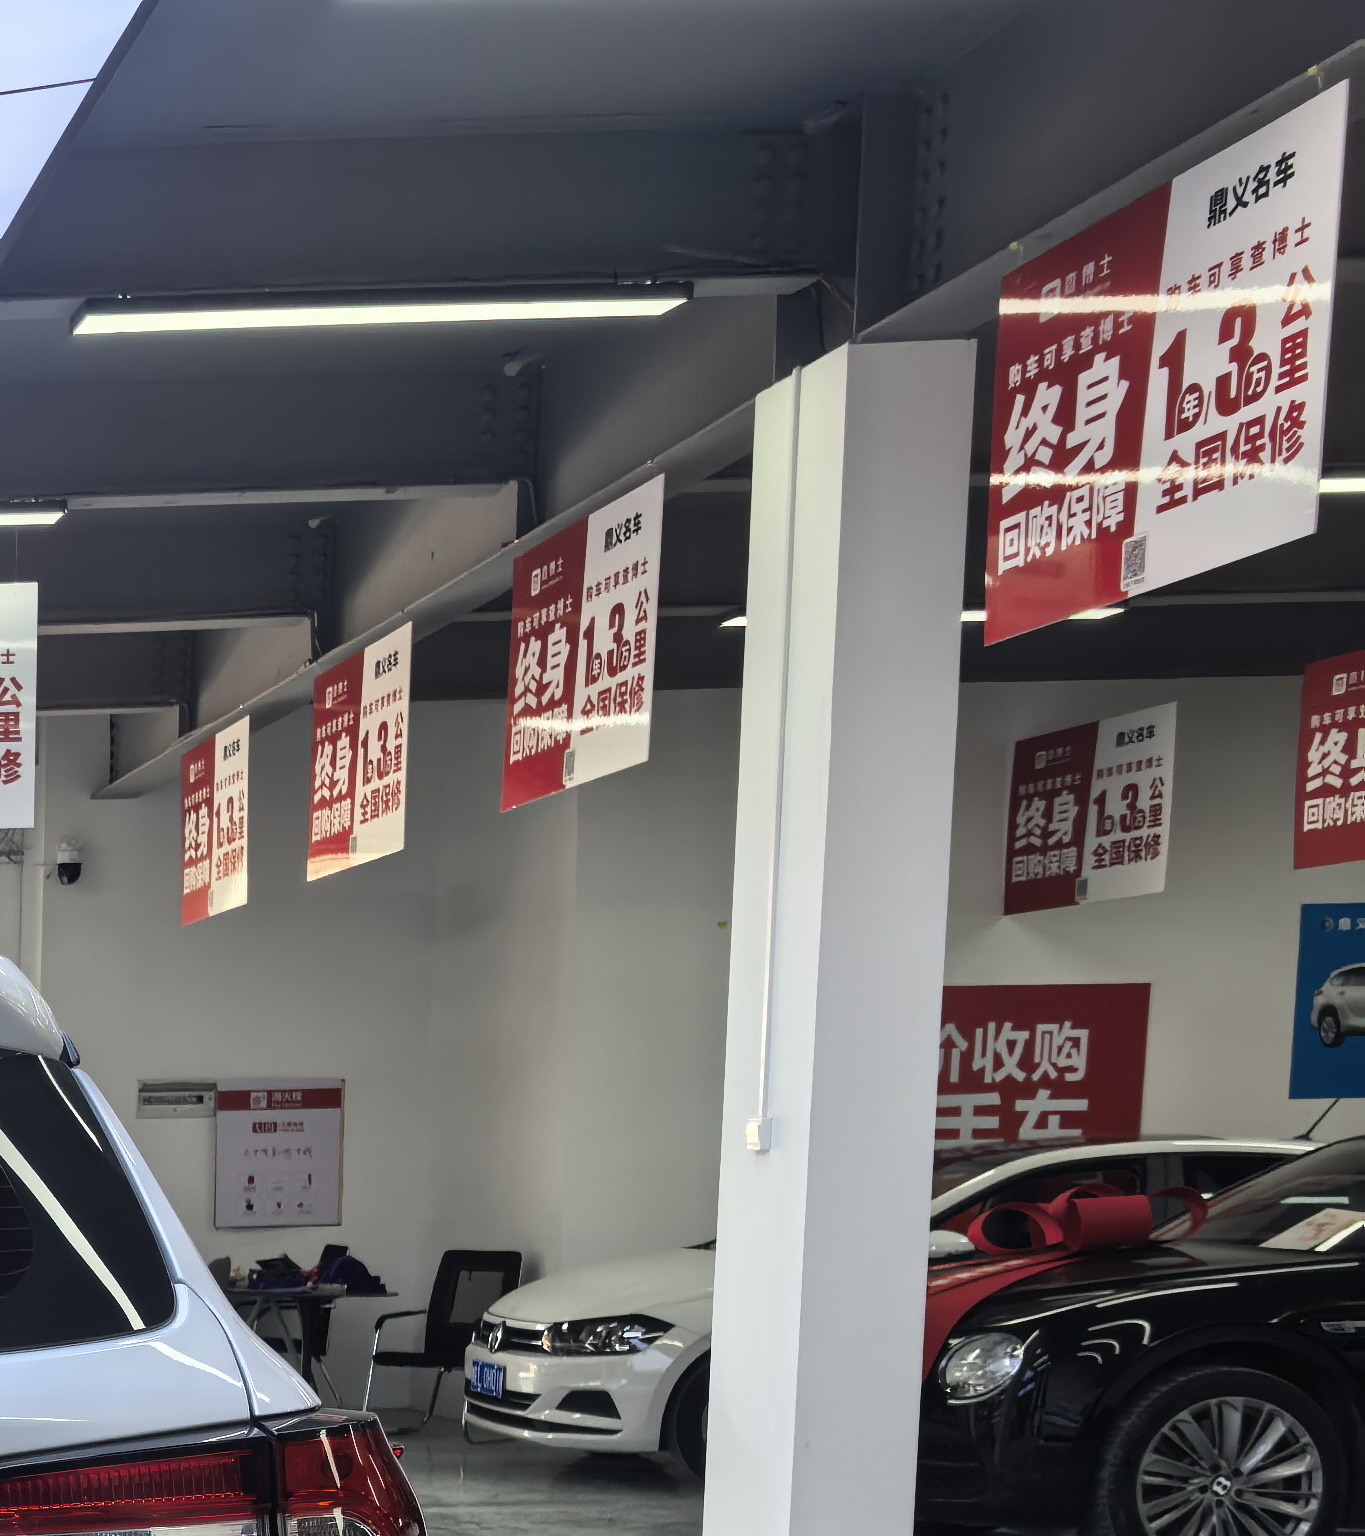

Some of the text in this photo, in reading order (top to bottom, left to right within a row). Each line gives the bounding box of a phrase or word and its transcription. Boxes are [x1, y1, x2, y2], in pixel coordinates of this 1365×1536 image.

[1207, 150, 1296, 229] 鼎义名车
[1008, 310, 1133, 390] 购车可享查博士
[1001, 351, 1130, 505] 终身
[1155, 398, 1308, 515] 全国保修
[604, 512, 642, 553] 鼎义名车
[997, 477, 1125, 576] 回购保障
[513, 623, 570, 717] 终身
[314, 732, 352, 804] 终身
[359, 778, 401, 825] 全国保修
[184, 803, 210, 862] 终身
[1014, 789, 1079, 849] 终身
[1092, 833, 1162, 870] 全国保修
[1012, 846, 1078, 883] 回购保障
